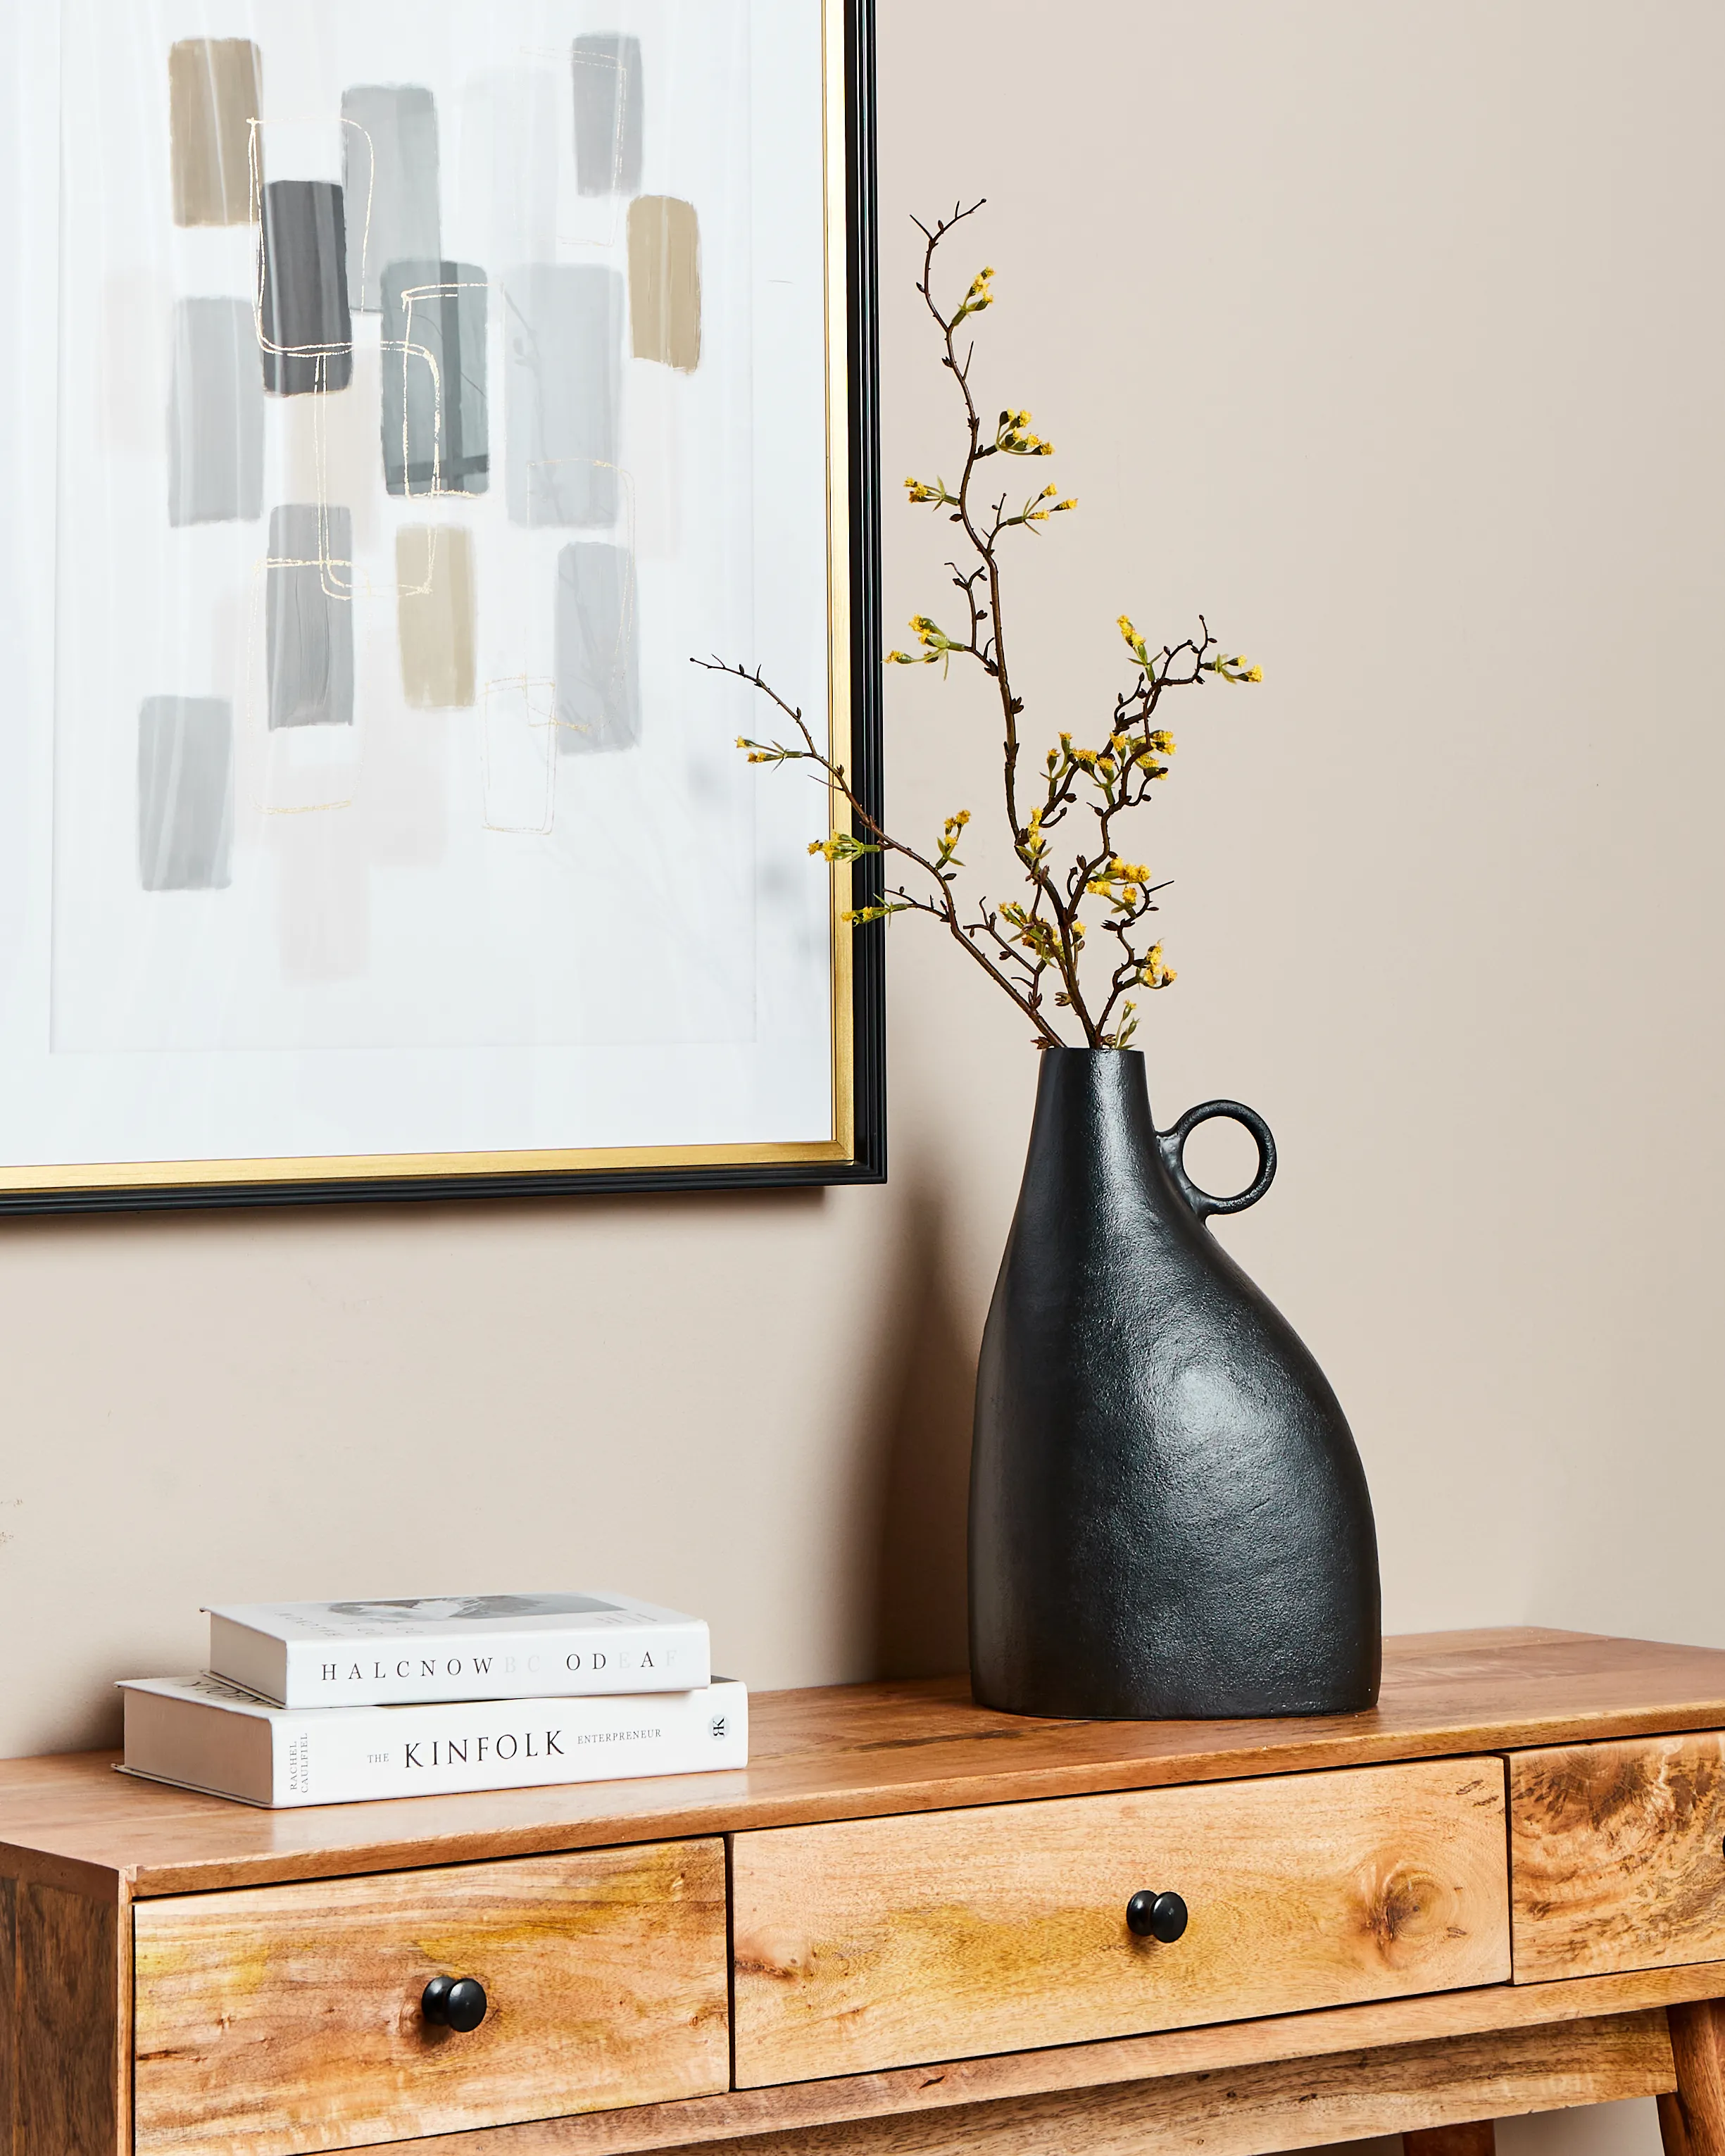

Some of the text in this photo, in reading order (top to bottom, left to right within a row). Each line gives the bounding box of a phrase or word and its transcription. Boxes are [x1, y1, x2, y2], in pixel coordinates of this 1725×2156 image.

[289, 1741, 298, 1791] RACHEL
[367, 1729, 662, 1769] THE KINFOLK ENTERPRENEUR
